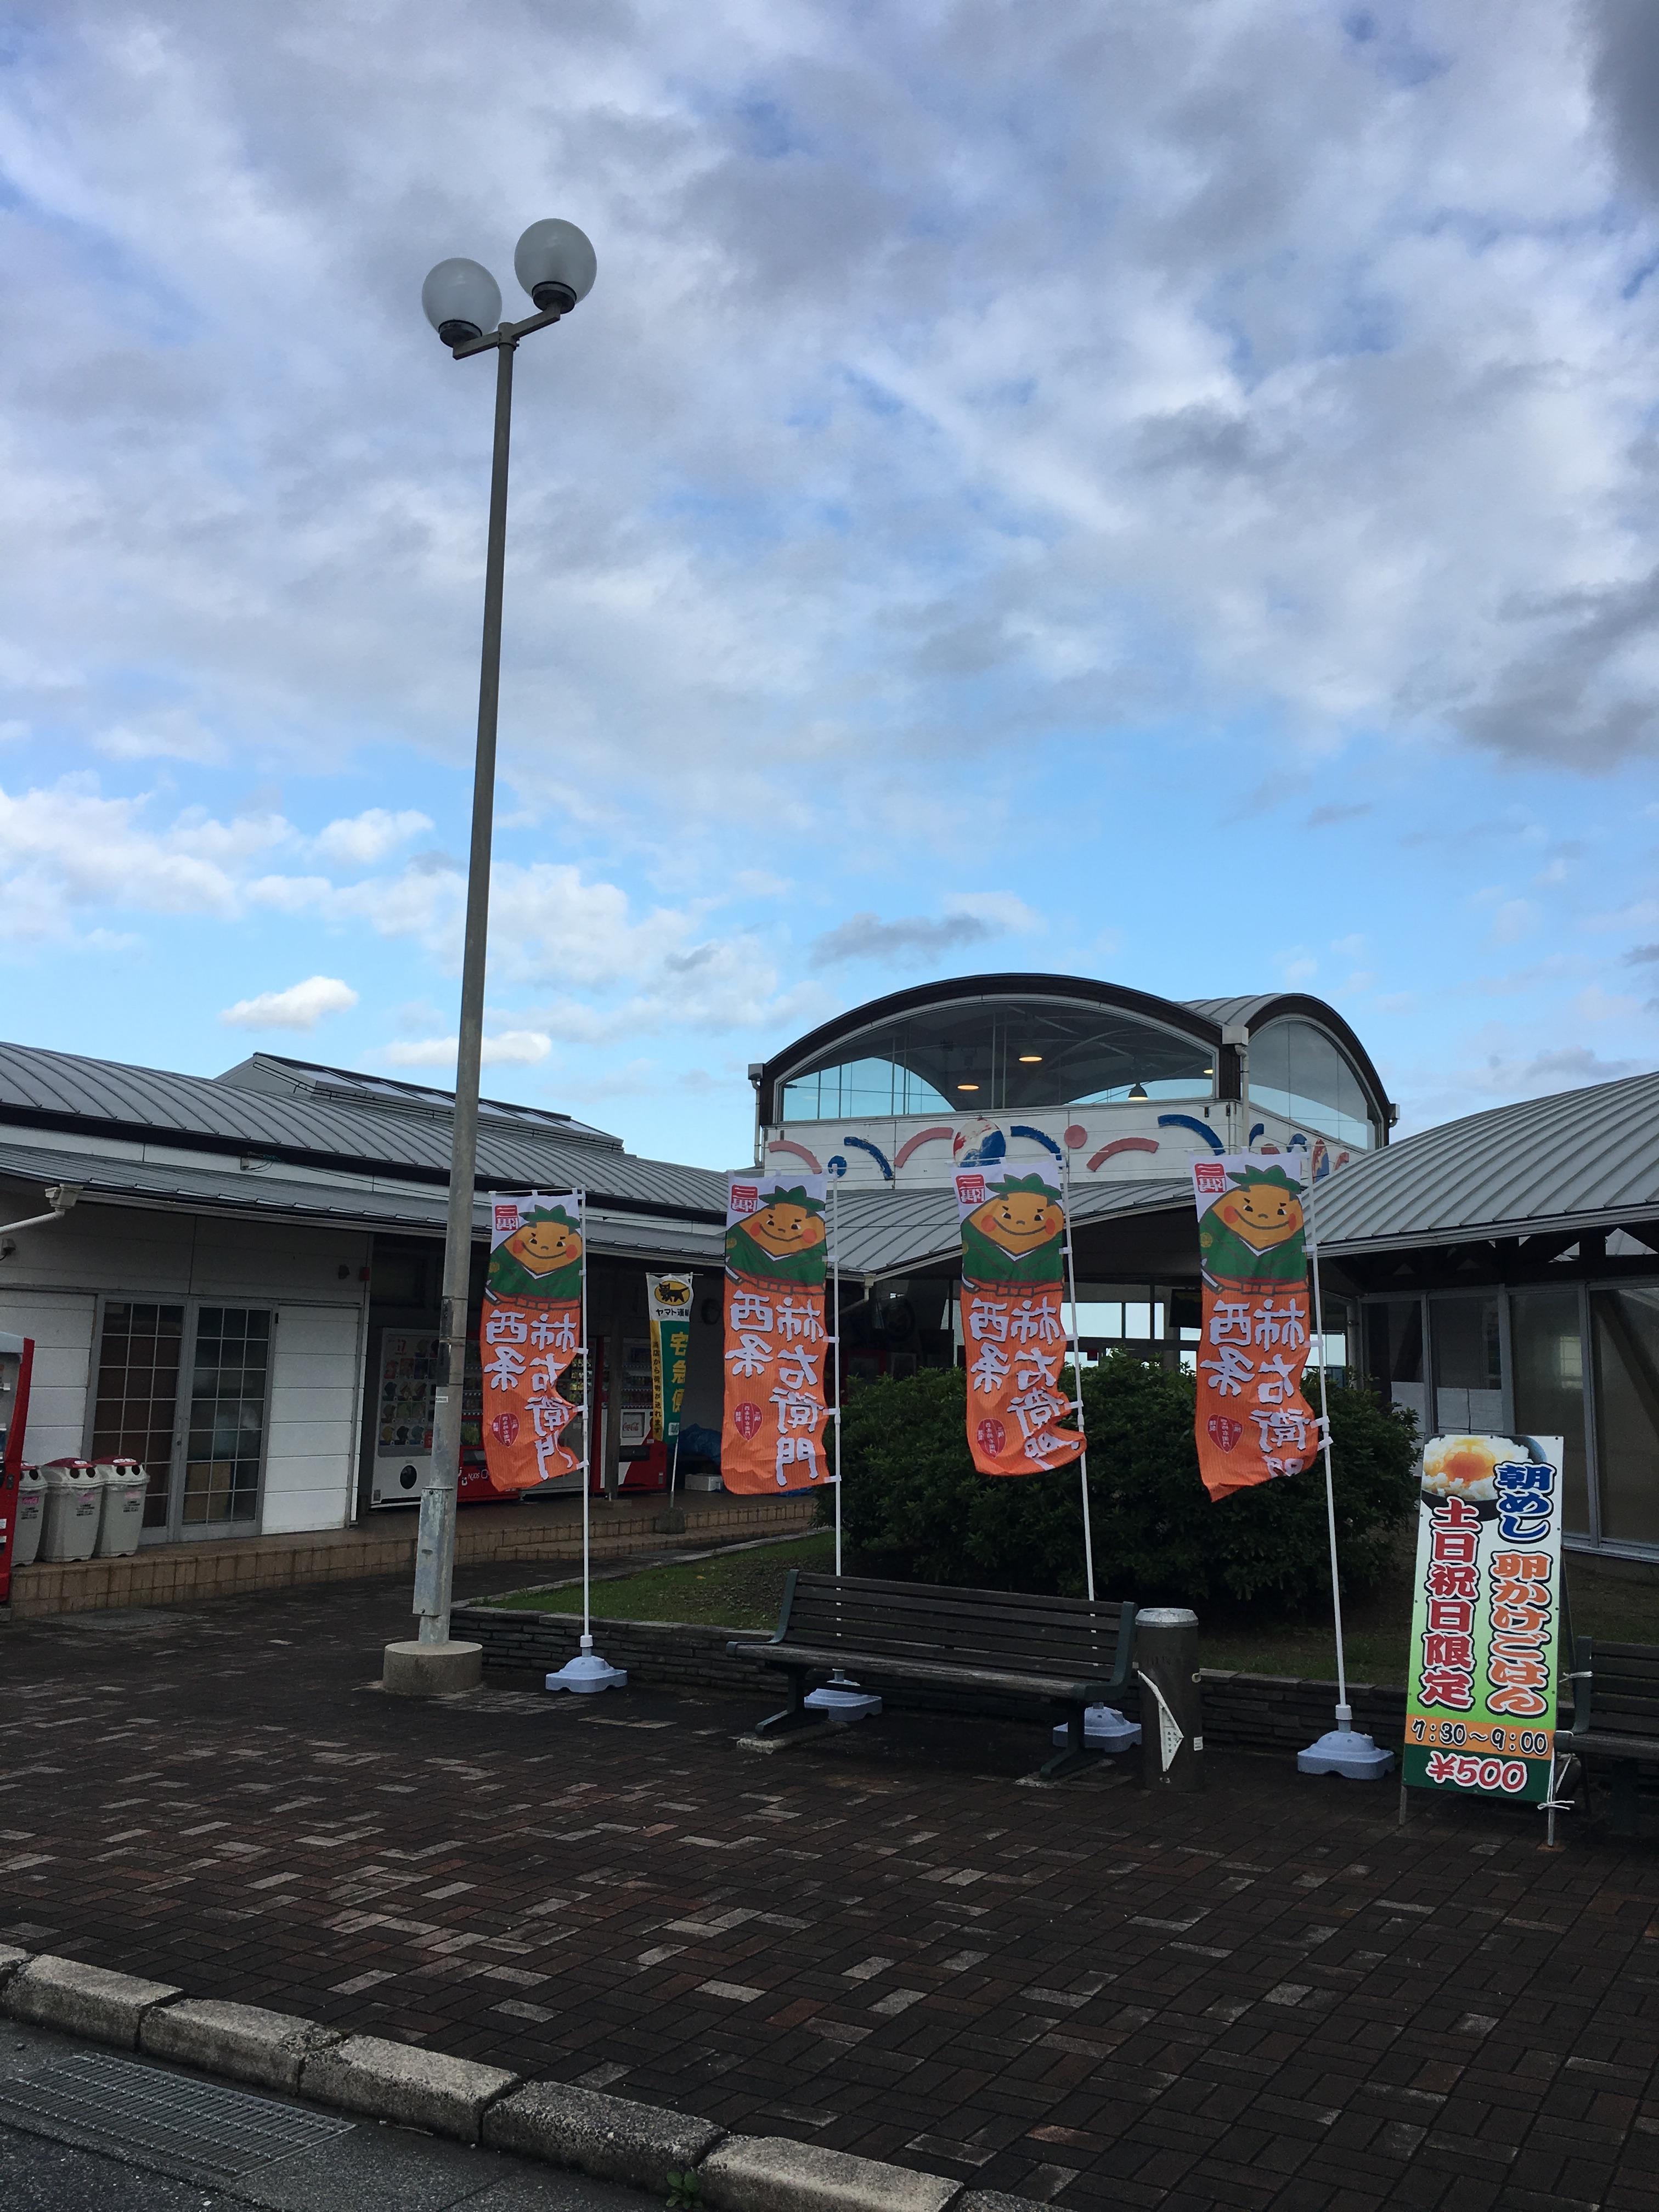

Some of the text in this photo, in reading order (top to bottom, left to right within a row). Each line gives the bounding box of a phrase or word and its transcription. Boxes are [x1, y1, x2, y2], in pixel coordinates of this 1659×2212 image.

[1420, 1496, 1479, 1709] 土日祝日限定
[1488, 1464, 1555, 1716] 朝めし 卵かけごはん
[1426, 1751, 1527, 1793] ¥500
